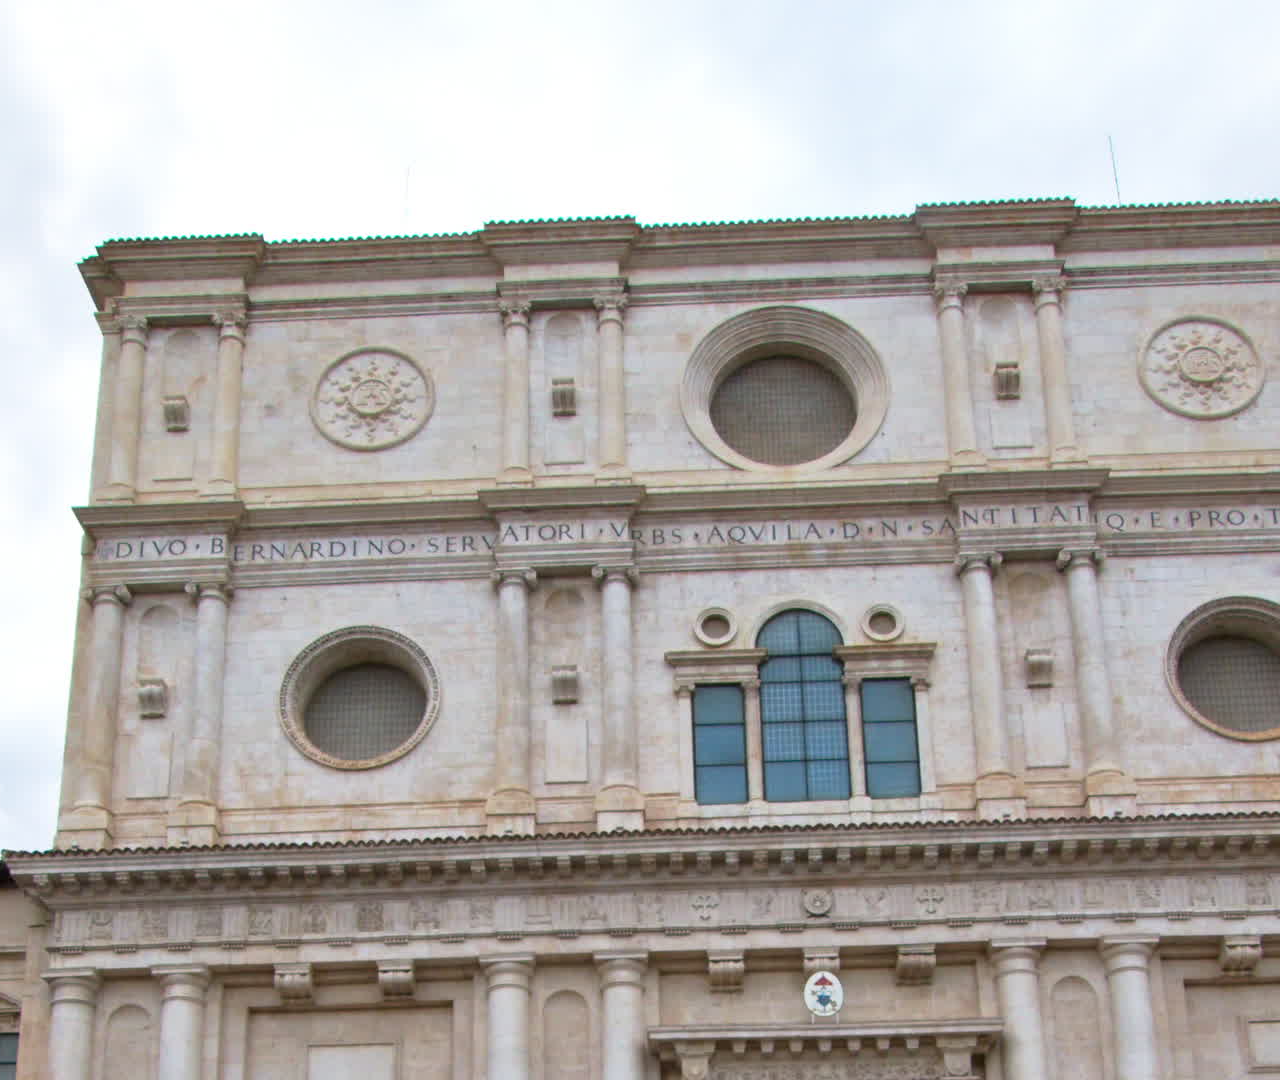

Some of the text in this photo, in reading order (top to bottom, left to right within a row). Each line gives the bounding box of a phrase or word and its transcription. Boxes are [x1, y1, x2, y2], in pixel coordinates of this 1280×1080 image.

[116, 538, 187, 558] DIVO
[210, 537, 407, 561] BERNARDINO
[427, 522, 586, 551] SERVATORI
[707, 522, 822, 545] AQVILA
[842, 522, 860, 540] D
[881, 519, 899, 538] N
[1150, 510, 1161, 529] E
[1188, 509, 1247, 528] PRO
